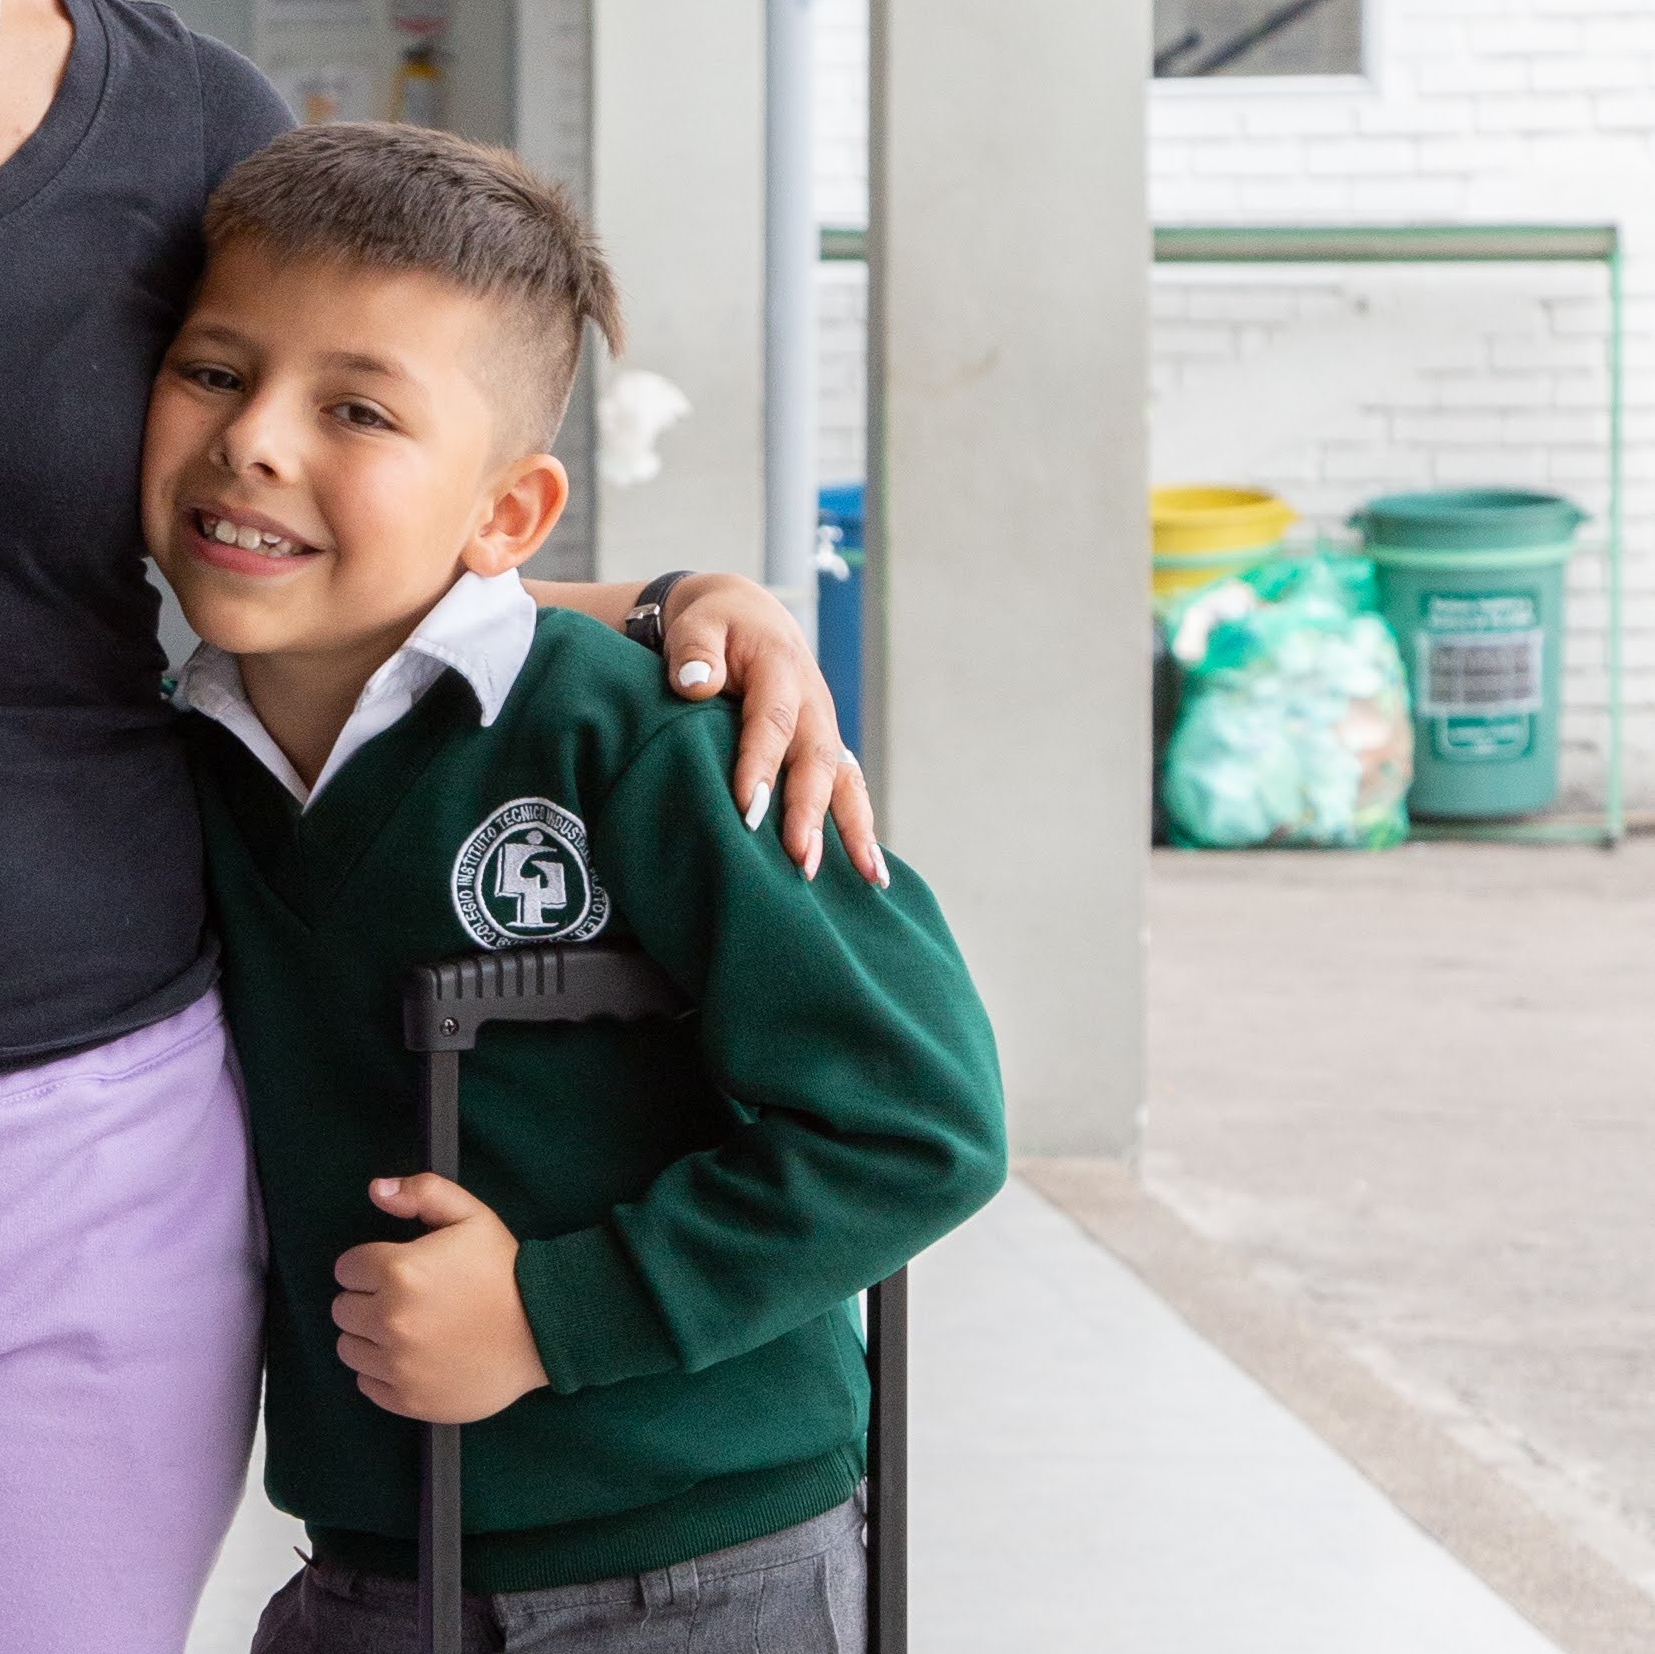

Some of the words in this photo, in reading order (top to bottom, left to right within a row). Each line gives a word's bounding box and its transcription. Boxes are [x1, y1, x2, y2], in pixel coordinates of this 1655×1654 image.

[496, 805, 545, 829] TECNICO
[545, 807, 590, 867] INDUST
[457, 827, 497, 886] INSTITUTO
[458, 890, 496, 943] COLEGIO
